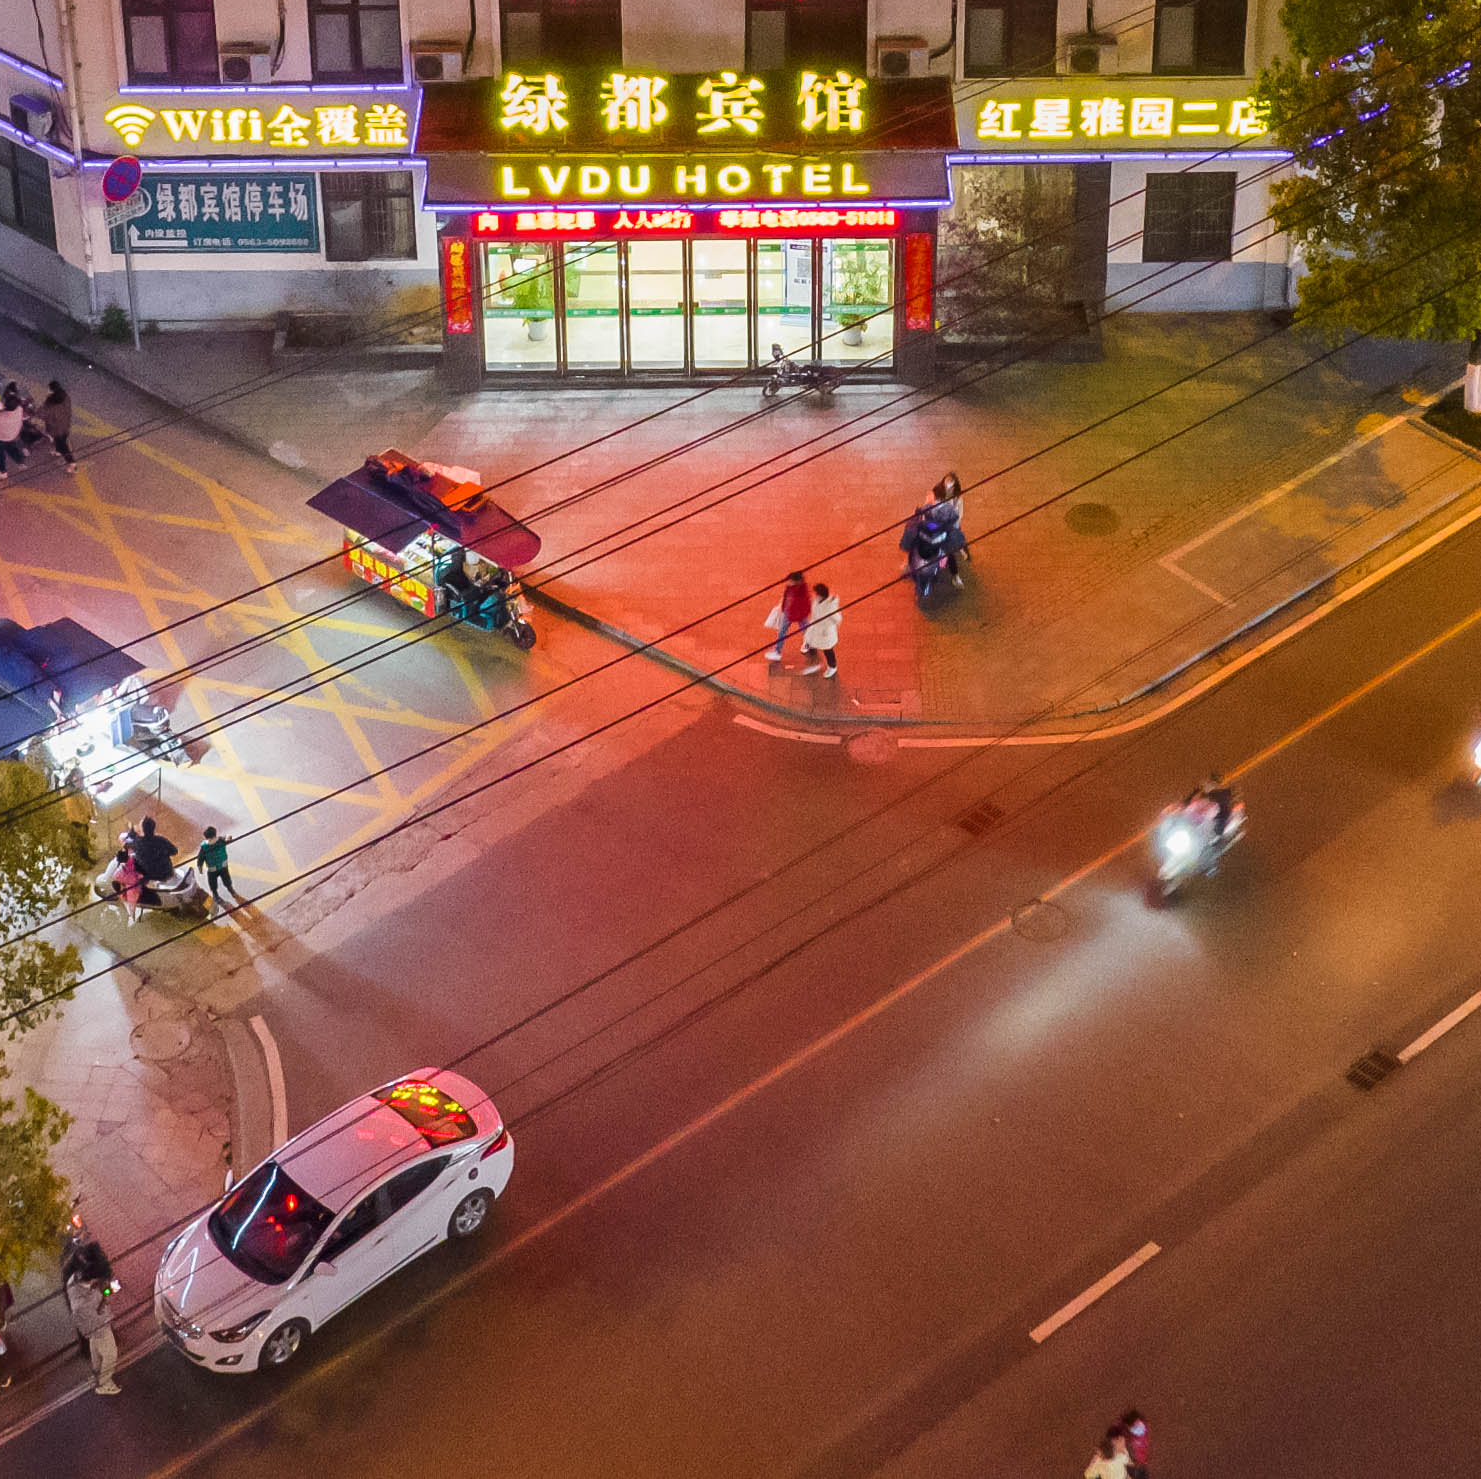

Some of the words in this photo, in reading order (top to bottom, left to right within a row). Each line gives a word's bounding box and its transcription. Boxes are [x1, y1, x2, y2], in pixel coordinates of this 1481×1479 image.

[499, 71, 868, 136] 绿都宾馆
[977, 96, 1272, 139] 红星雅园二店
[160, 104, 409, 147] Wifi全覆盖
[500, 164, 652, 196] LVDU
[673, 161, 871, 195] HOTEL
[155, 181, 309, 223] 绿都宾馆停车场
